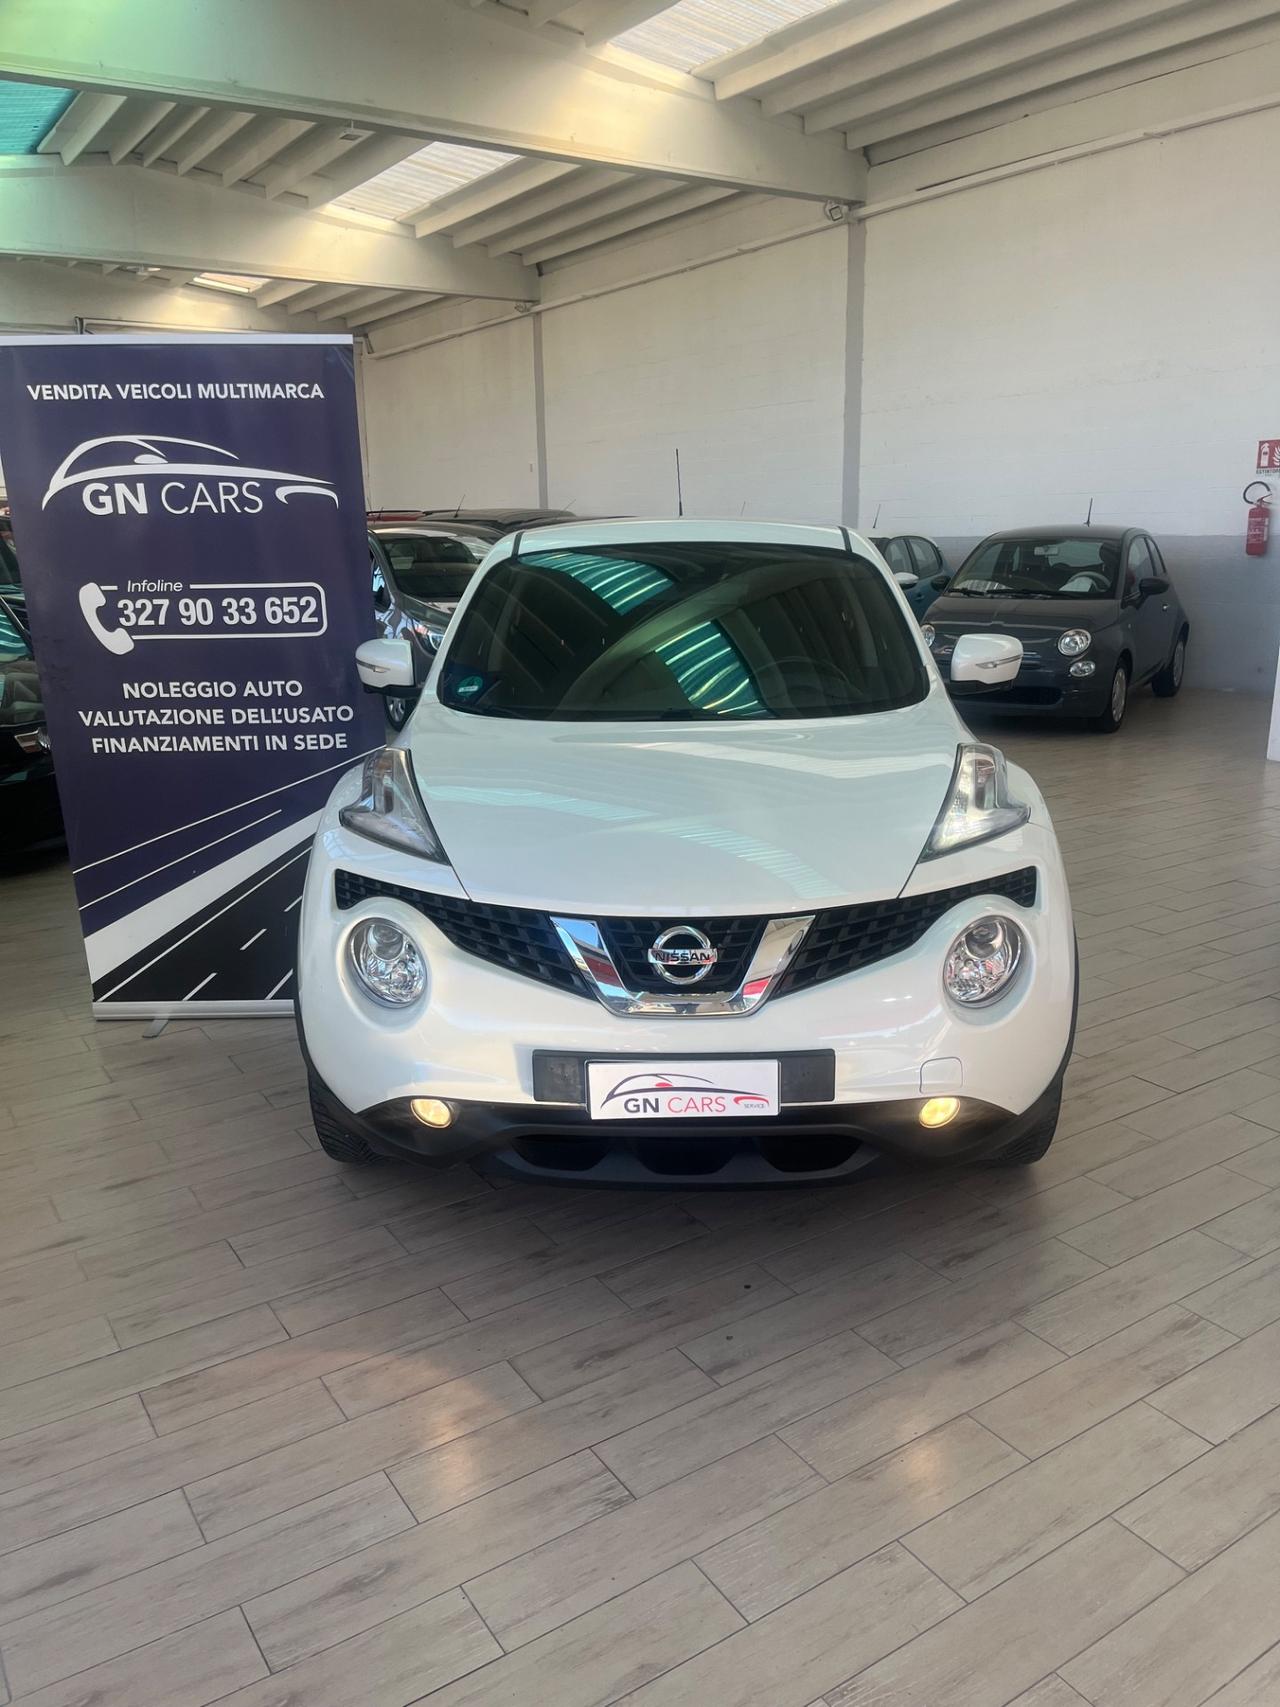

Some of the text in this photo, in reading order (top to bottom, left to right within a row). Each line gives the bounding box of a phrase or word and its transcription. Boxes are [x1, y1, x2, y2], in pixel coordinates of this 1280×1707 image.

[27, 383, 324, 400] VENDITA VEICOLI MULTIMARCA
[82, 481, 263, 515] GN CARS
[127, 579, 183, 592] Infoline
[117, 596, 318, 626] 327 90 33 652
[123, 680, 303, 699] NOLEGGIO AUTO
[79, 708, 225, 727] VALUTAZIONE
[92, 733, 348, 753] FINANZIAMENTI IN SEDE
[655, 952, 710, 962] NISSAN
[624, 1097, 726, 1113] GN CARS
